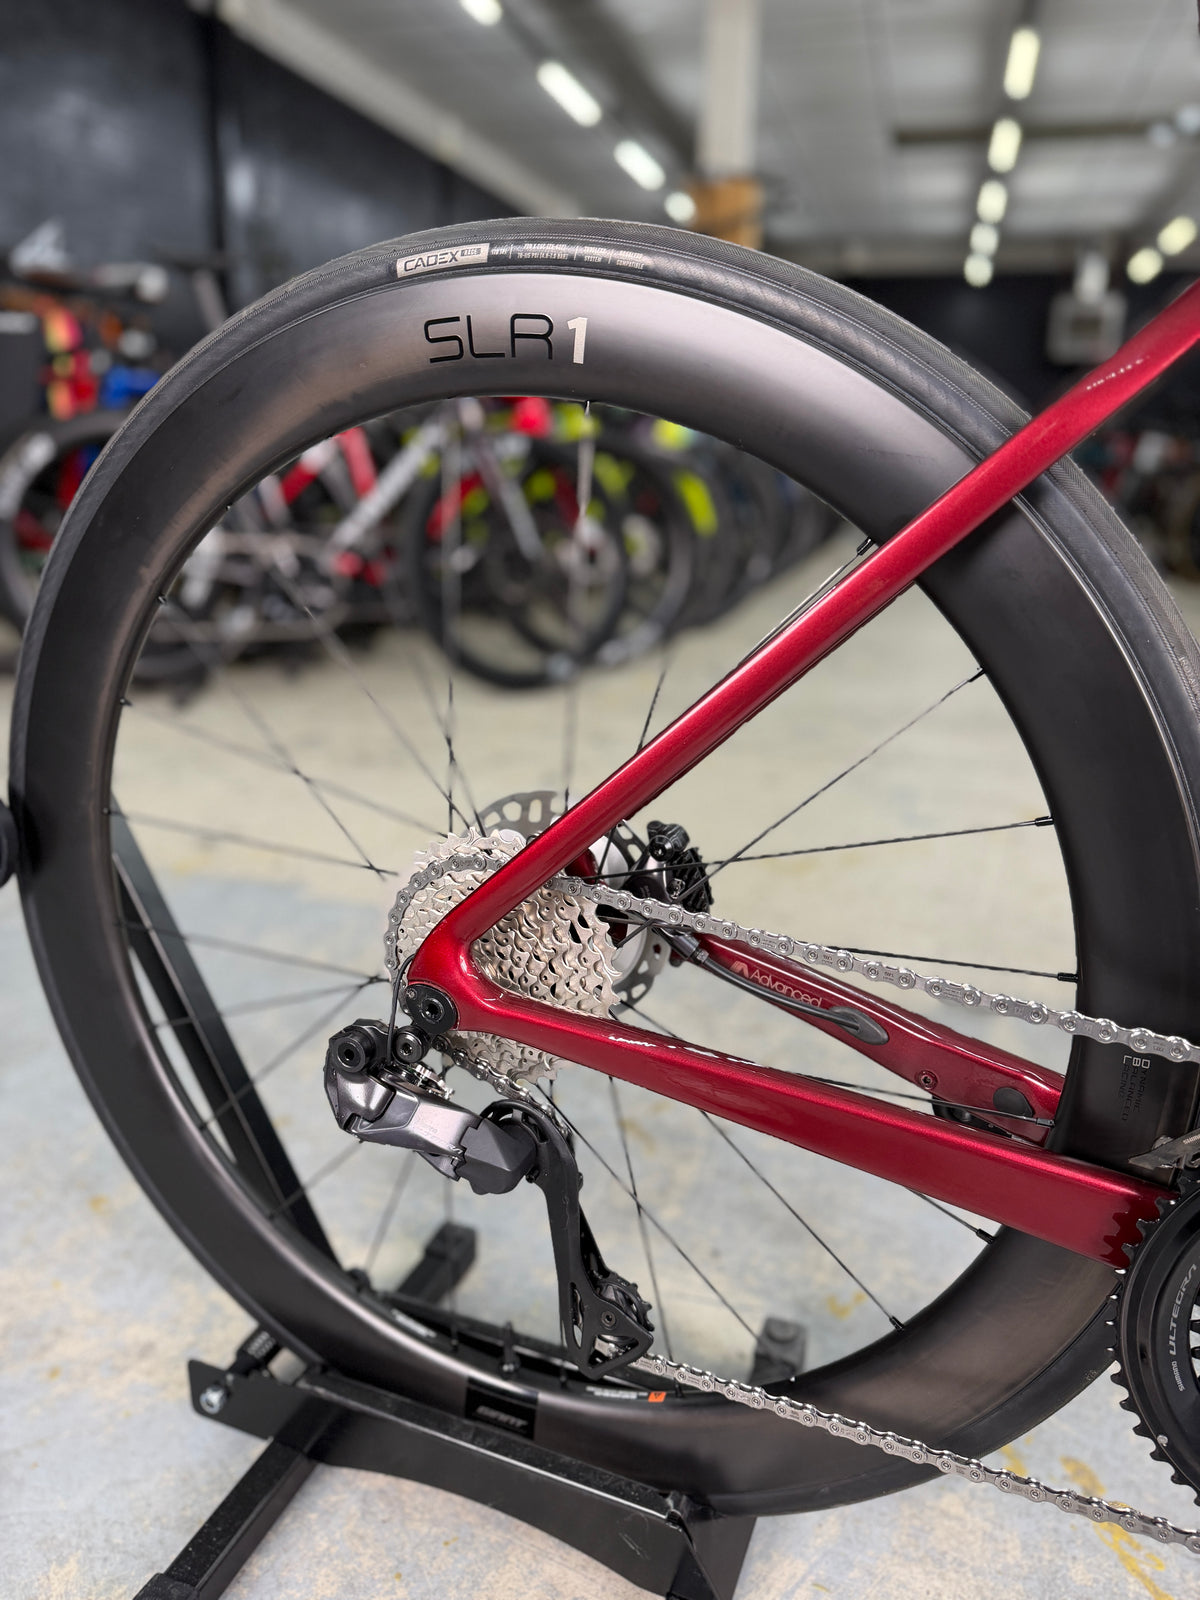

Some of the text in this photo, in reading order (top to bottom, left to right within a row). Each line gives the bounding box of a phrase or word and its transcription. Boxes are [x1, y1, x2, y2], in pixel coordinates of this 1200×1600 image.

[404, 250, 459, 272] CADEX
[424, 313, 588, 364] SLR 1
[749, 969, 822, 1007] Advanced
[1169, 1263, 1197, 1391] SHIMANO ULTEGRA
